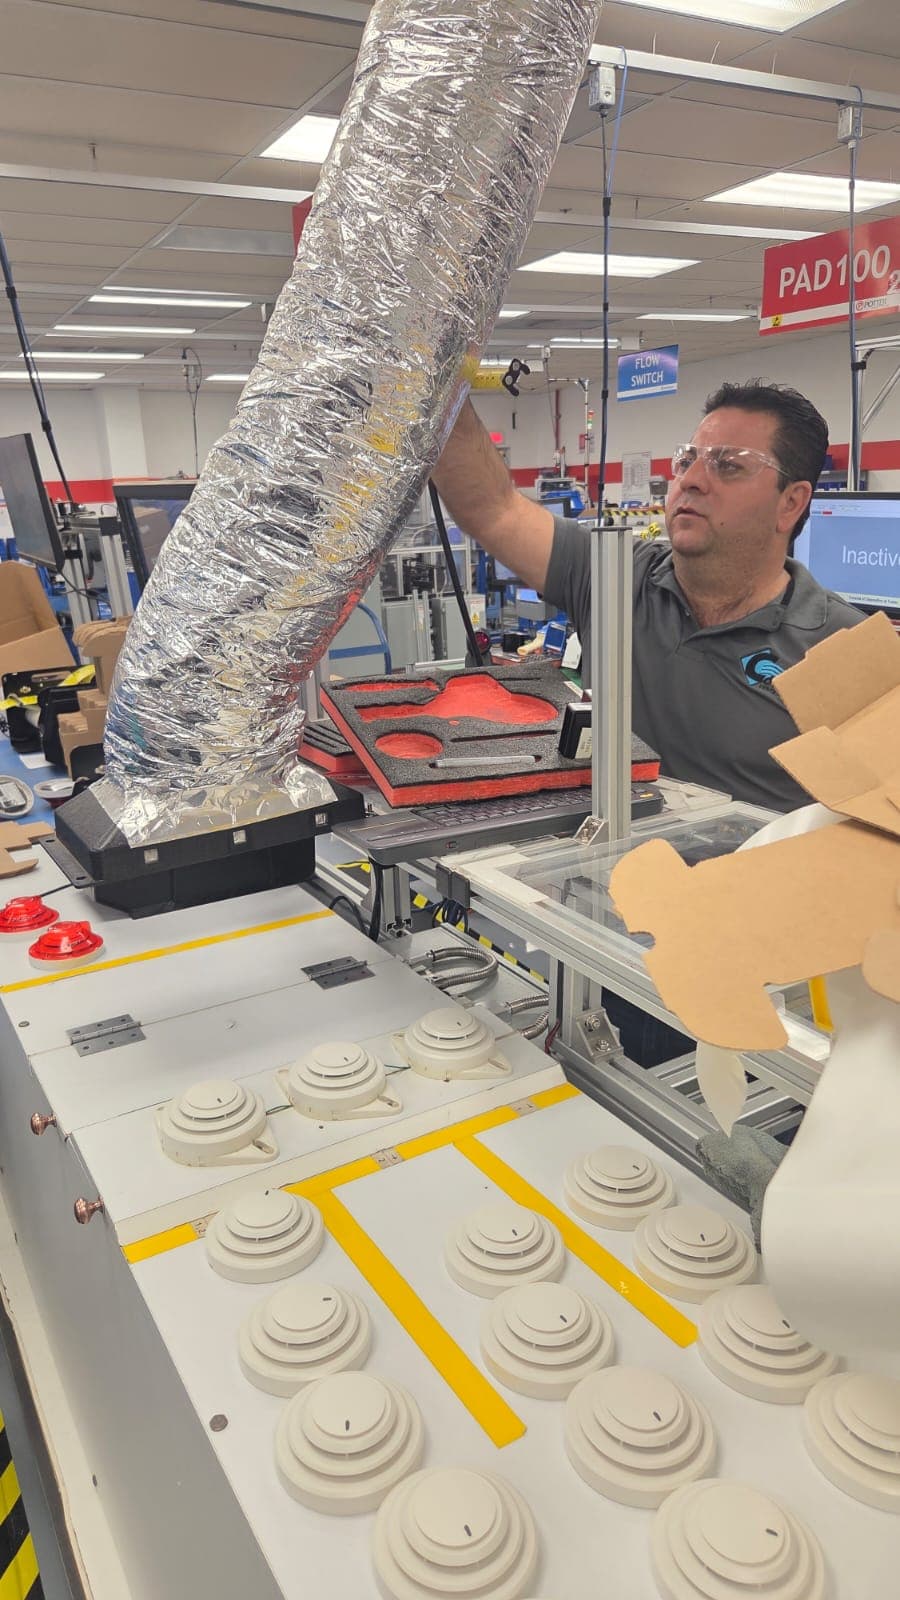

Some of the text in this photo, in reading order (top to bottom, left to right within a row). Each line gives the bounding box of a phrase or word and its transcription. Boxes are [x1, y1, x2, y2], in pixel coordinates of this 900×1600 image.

[779, 245, 890, 298] PAD100
[635, 352, 659, 369] FLOW
[631, 370, 664, 387] SWITCH
[842, 545, 900, 568] Inactiv
